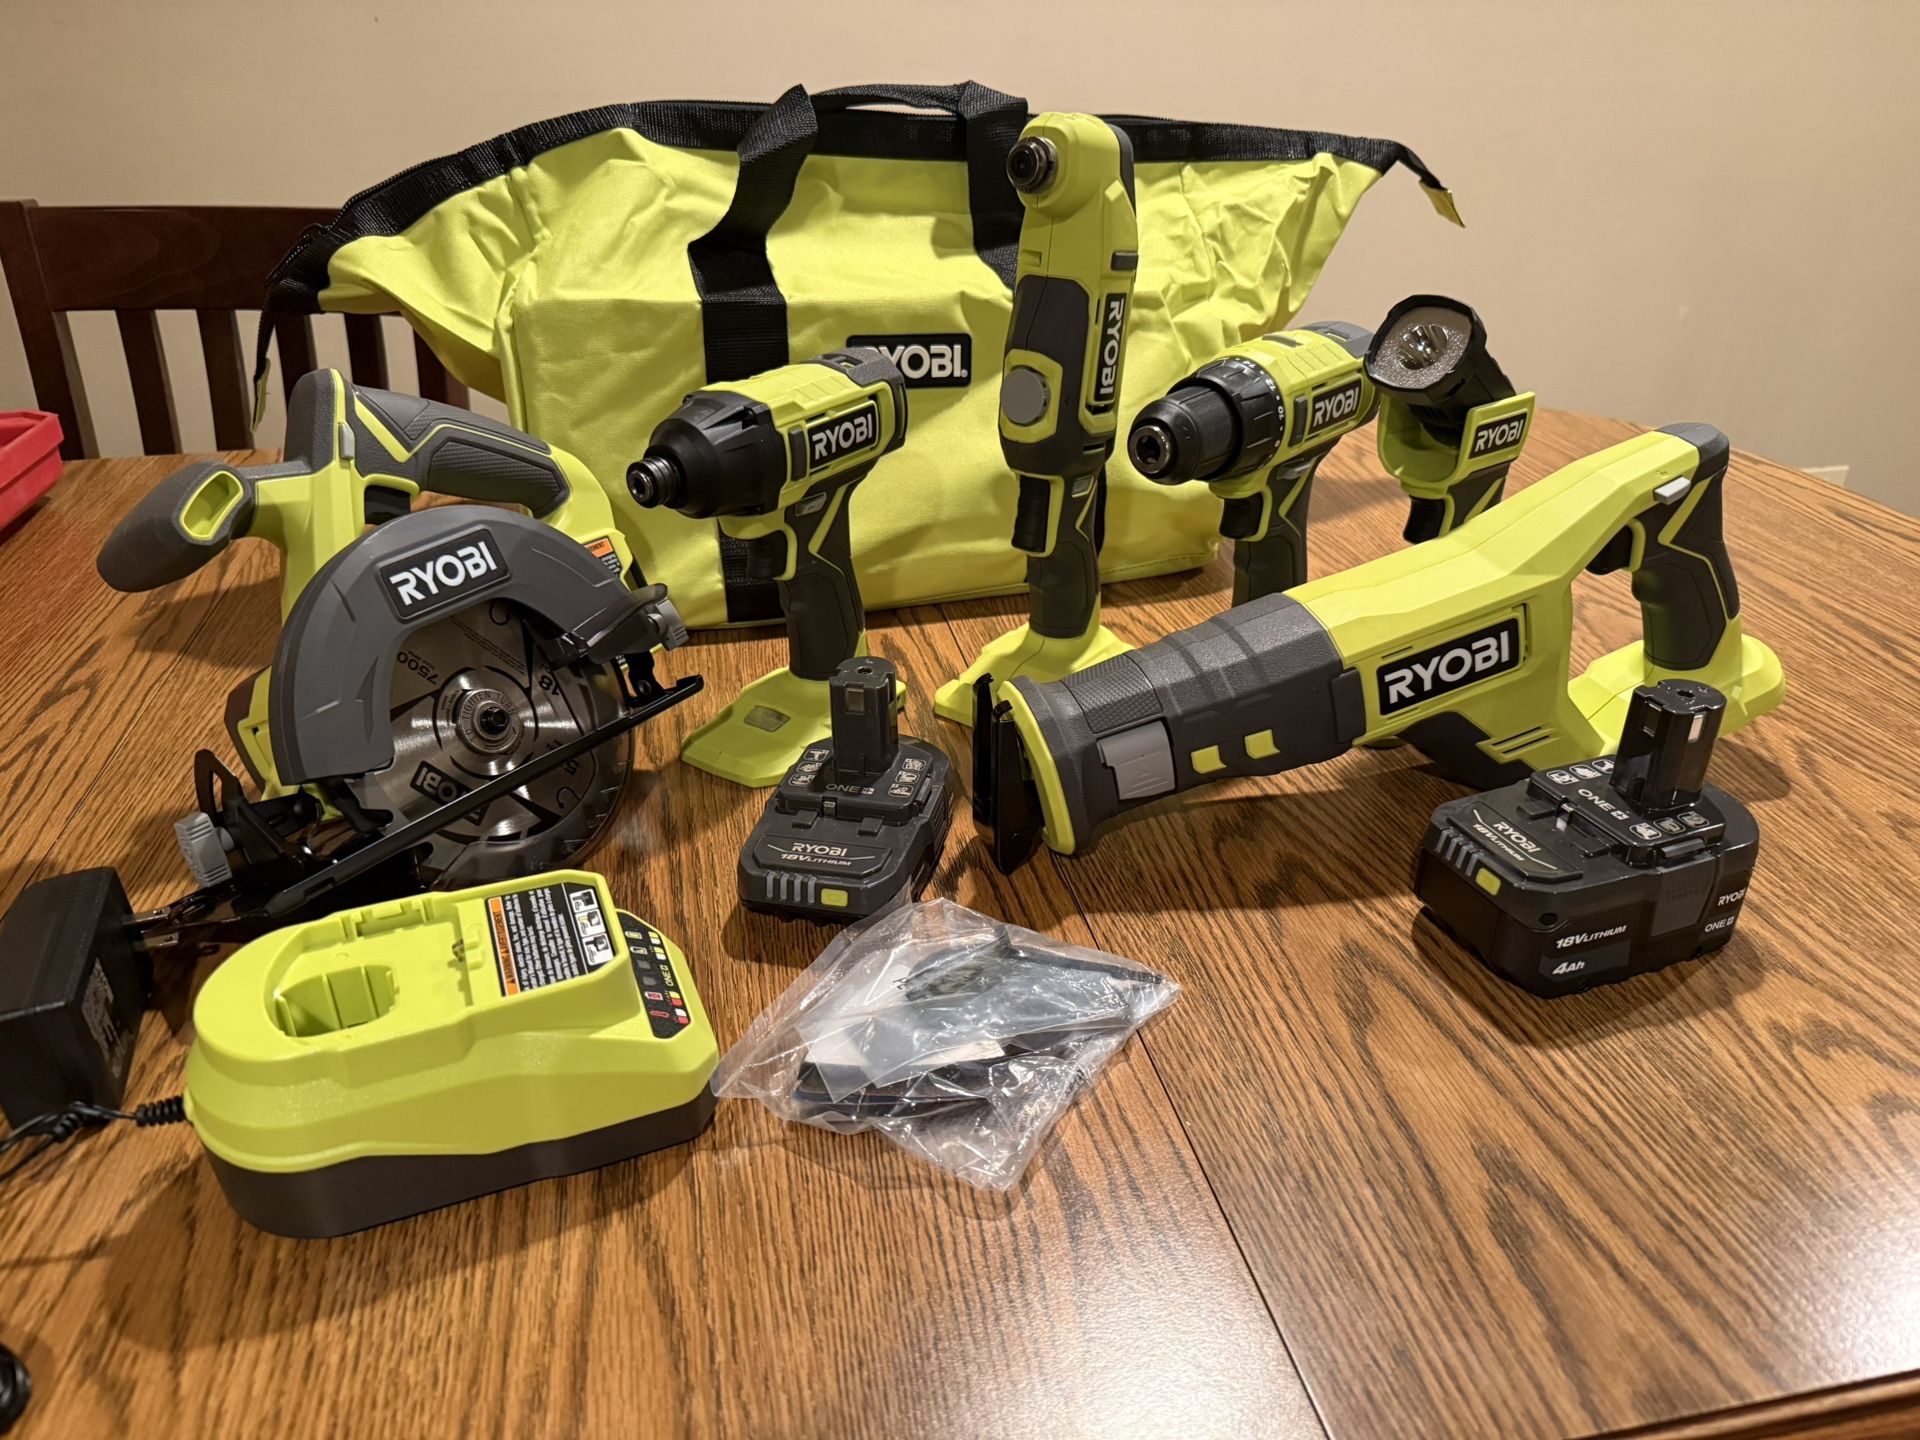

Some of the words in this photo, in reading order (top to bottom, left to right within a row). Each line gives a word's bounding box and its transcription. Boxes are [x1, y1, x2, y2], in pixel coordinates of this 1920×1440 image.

[863, 345, 963, 379] YOBI
[1099, 298, 1125, 395] RYOBI
[1312, 386, 1360, 428] RYOBI
[811, 412, 873, 461] RYOBI
[1474, 418, 1525, 453] RYOBI
[388, 540, 498, 607] RYOBI
[396, 651, 439, 686] 7500
[1383, 630, 1510, 705] RYOBI
[539, 675, 560, 697] 18
[791, 842, 849, 857] RYOBI
[1492, 821, 1542, 853] RYOBI
[1552, 960, 1586, 975] 4Ah
